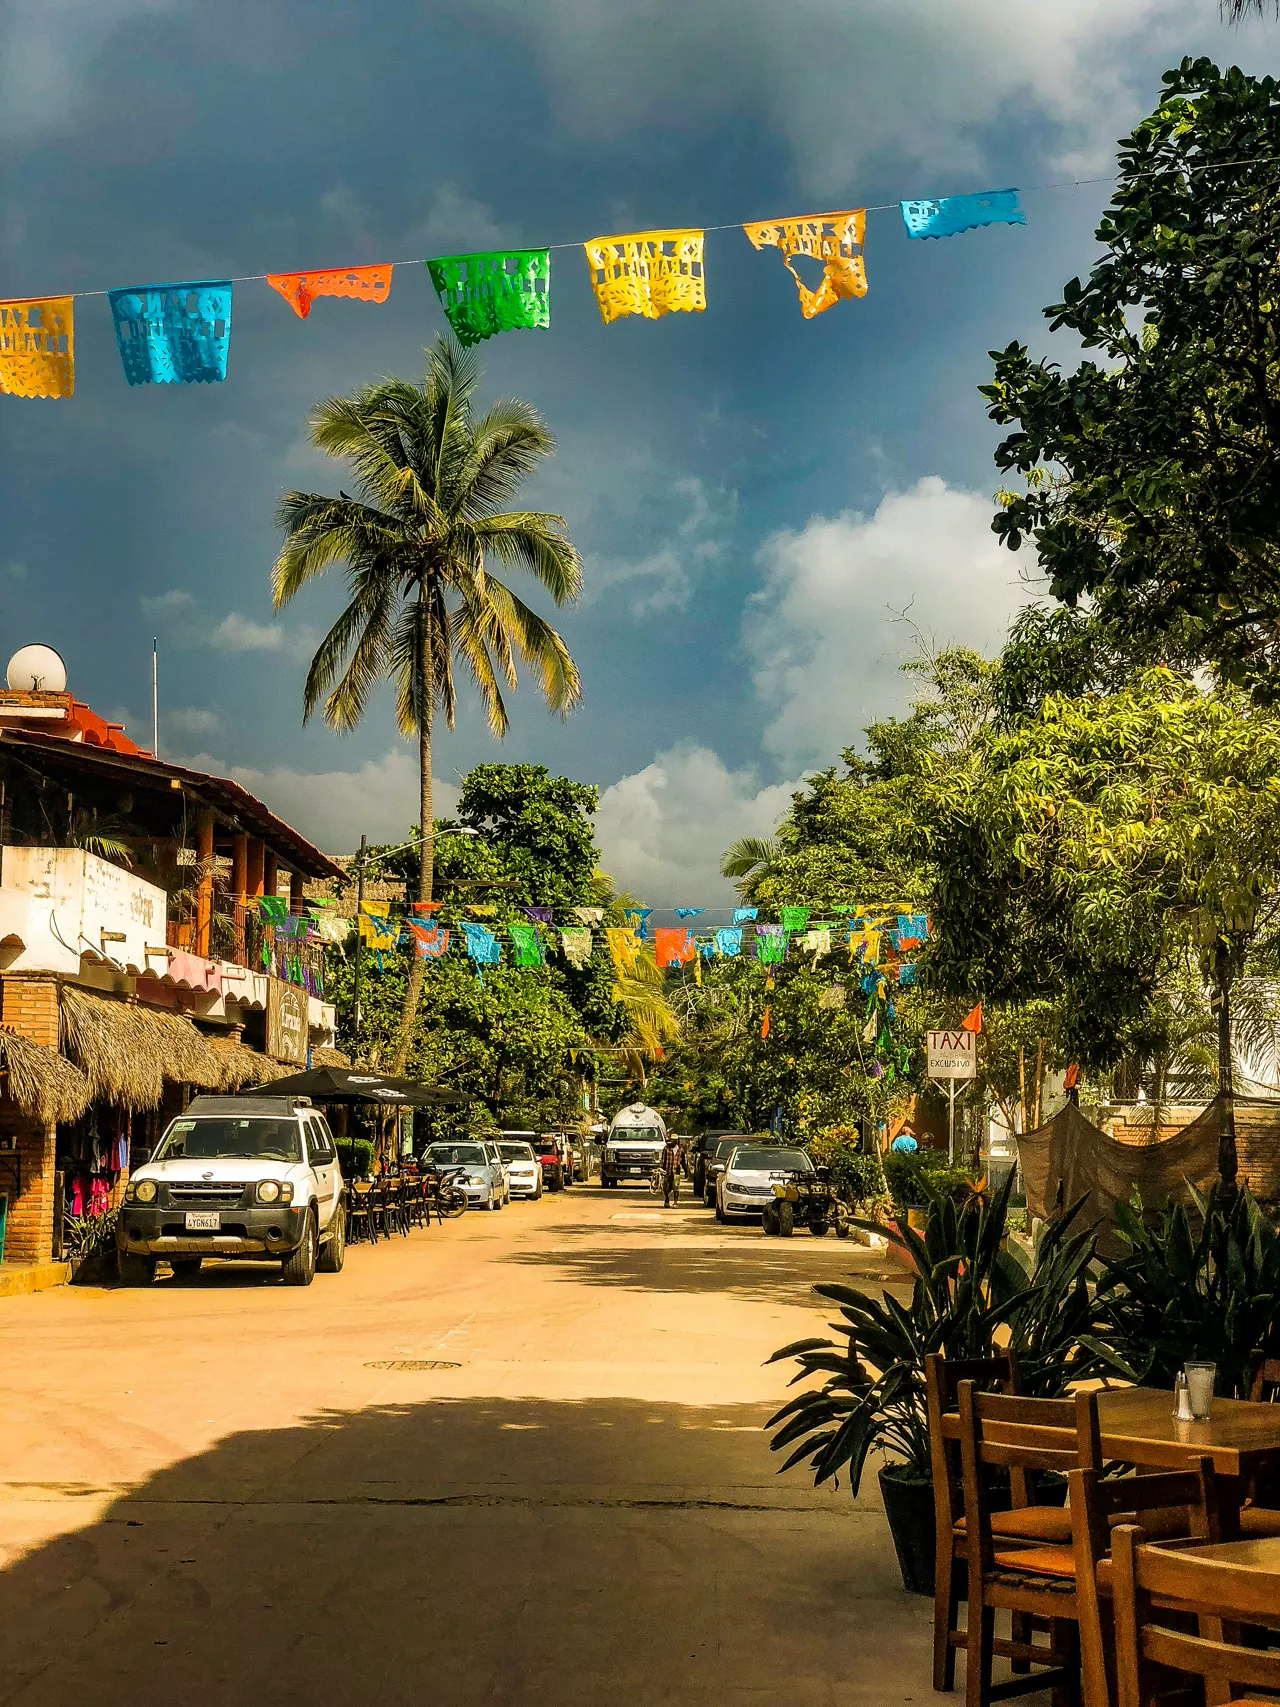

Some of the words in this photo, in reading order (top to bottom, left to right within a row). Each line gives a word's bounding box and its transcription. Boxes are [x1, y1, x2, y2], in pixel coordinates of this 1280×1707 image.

[929, 1031, 971, 1050] TAXI
[930, 1059, 970, 1068] EXCLUSIVO
[187, 1218, 218, 1228] 4YGN617
